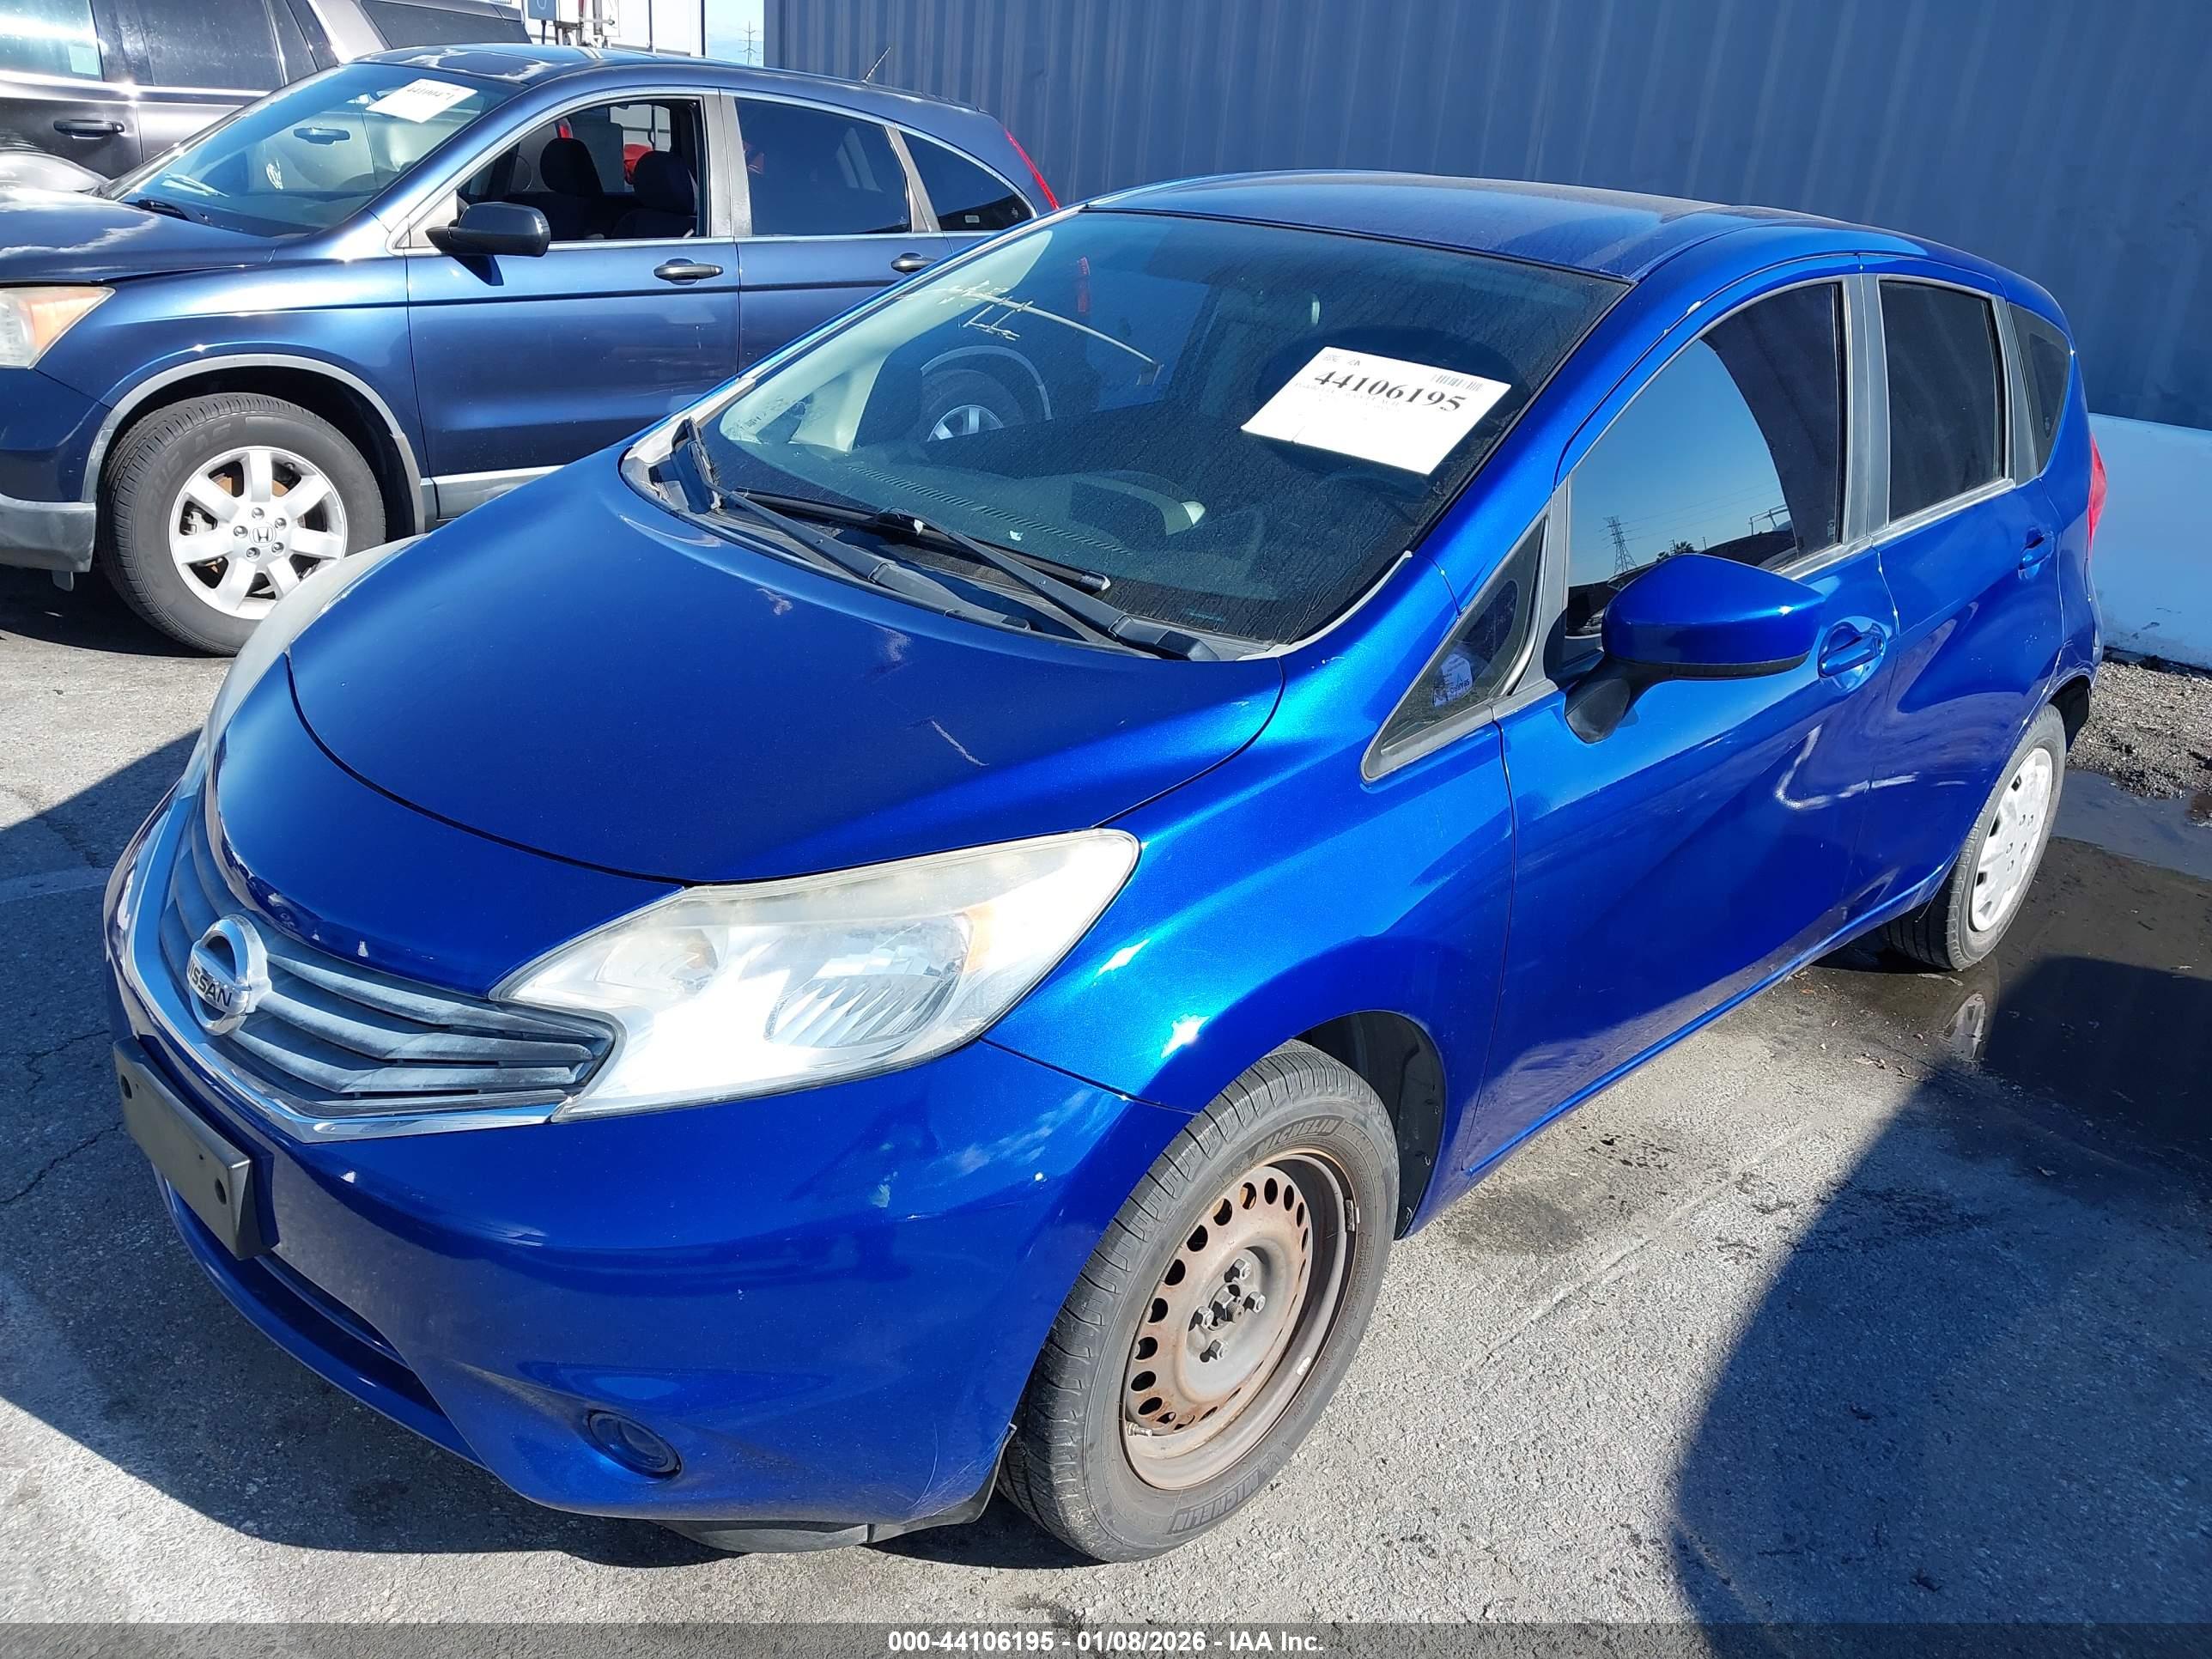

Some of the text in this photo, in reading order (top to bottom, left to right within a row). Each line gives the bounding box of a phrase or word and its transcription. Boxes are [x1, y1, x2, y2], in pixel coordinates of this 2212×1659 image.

[1315, 370, 1467, 412] 44106195
[1255, 1118, 1340, 1154] MICHELIN
[1171, 1471, 1260, 1532] MICHELIN
